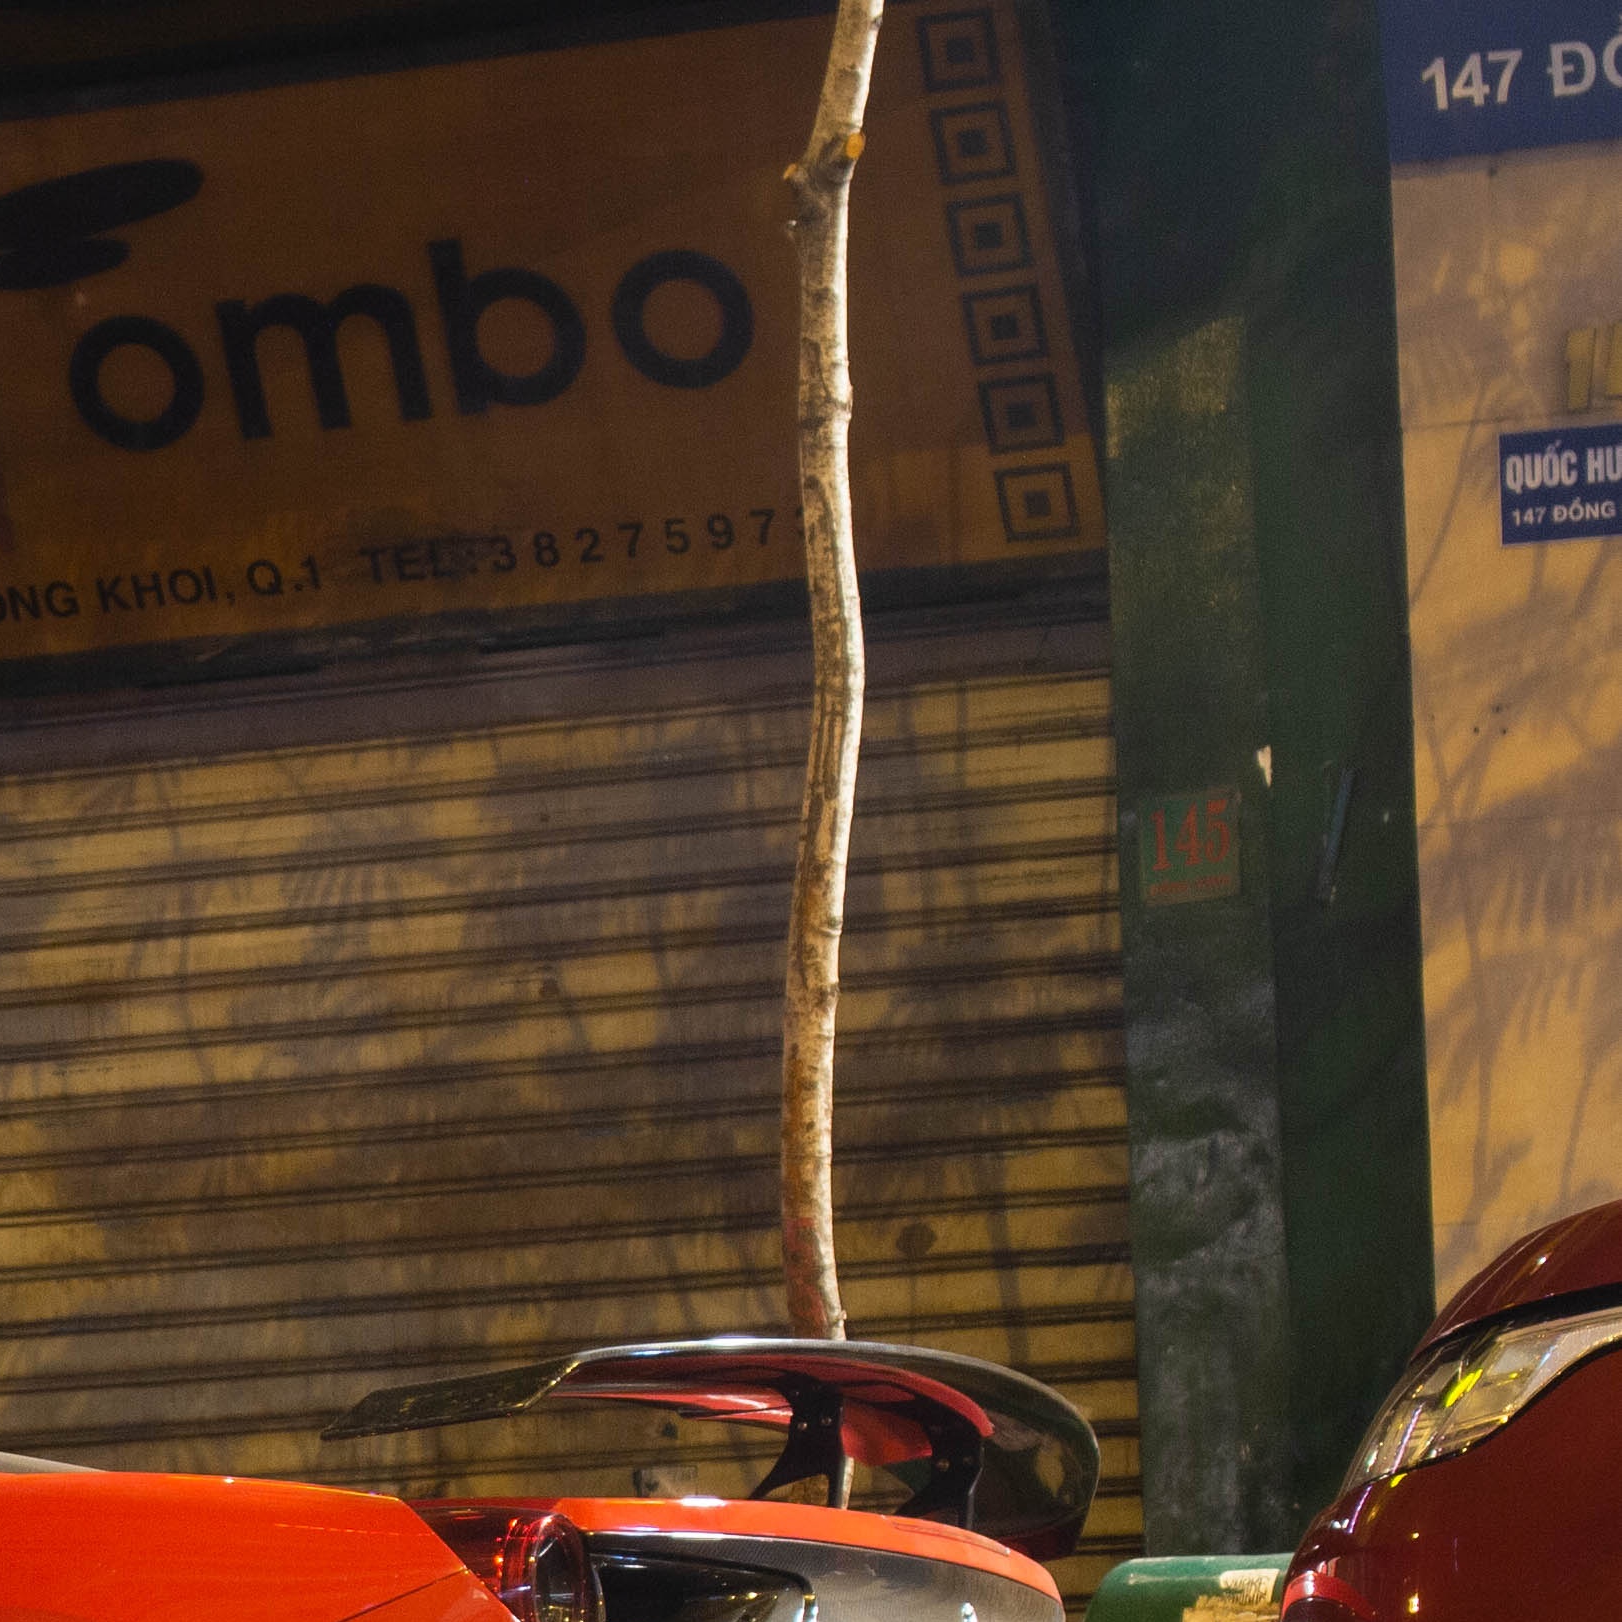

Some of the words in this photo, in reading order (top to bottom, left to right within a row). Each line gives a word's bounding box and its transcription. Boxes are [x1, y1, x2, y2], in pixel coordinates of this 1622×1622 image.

[1422, 49, 1523, 111] 147
[1505, 440, 1578, 494] QUỐC
[1512, 506, 1547, 527] 147
[246, 553, 322, 596] Q.1
[1150, 798, 1231, 871] 145
